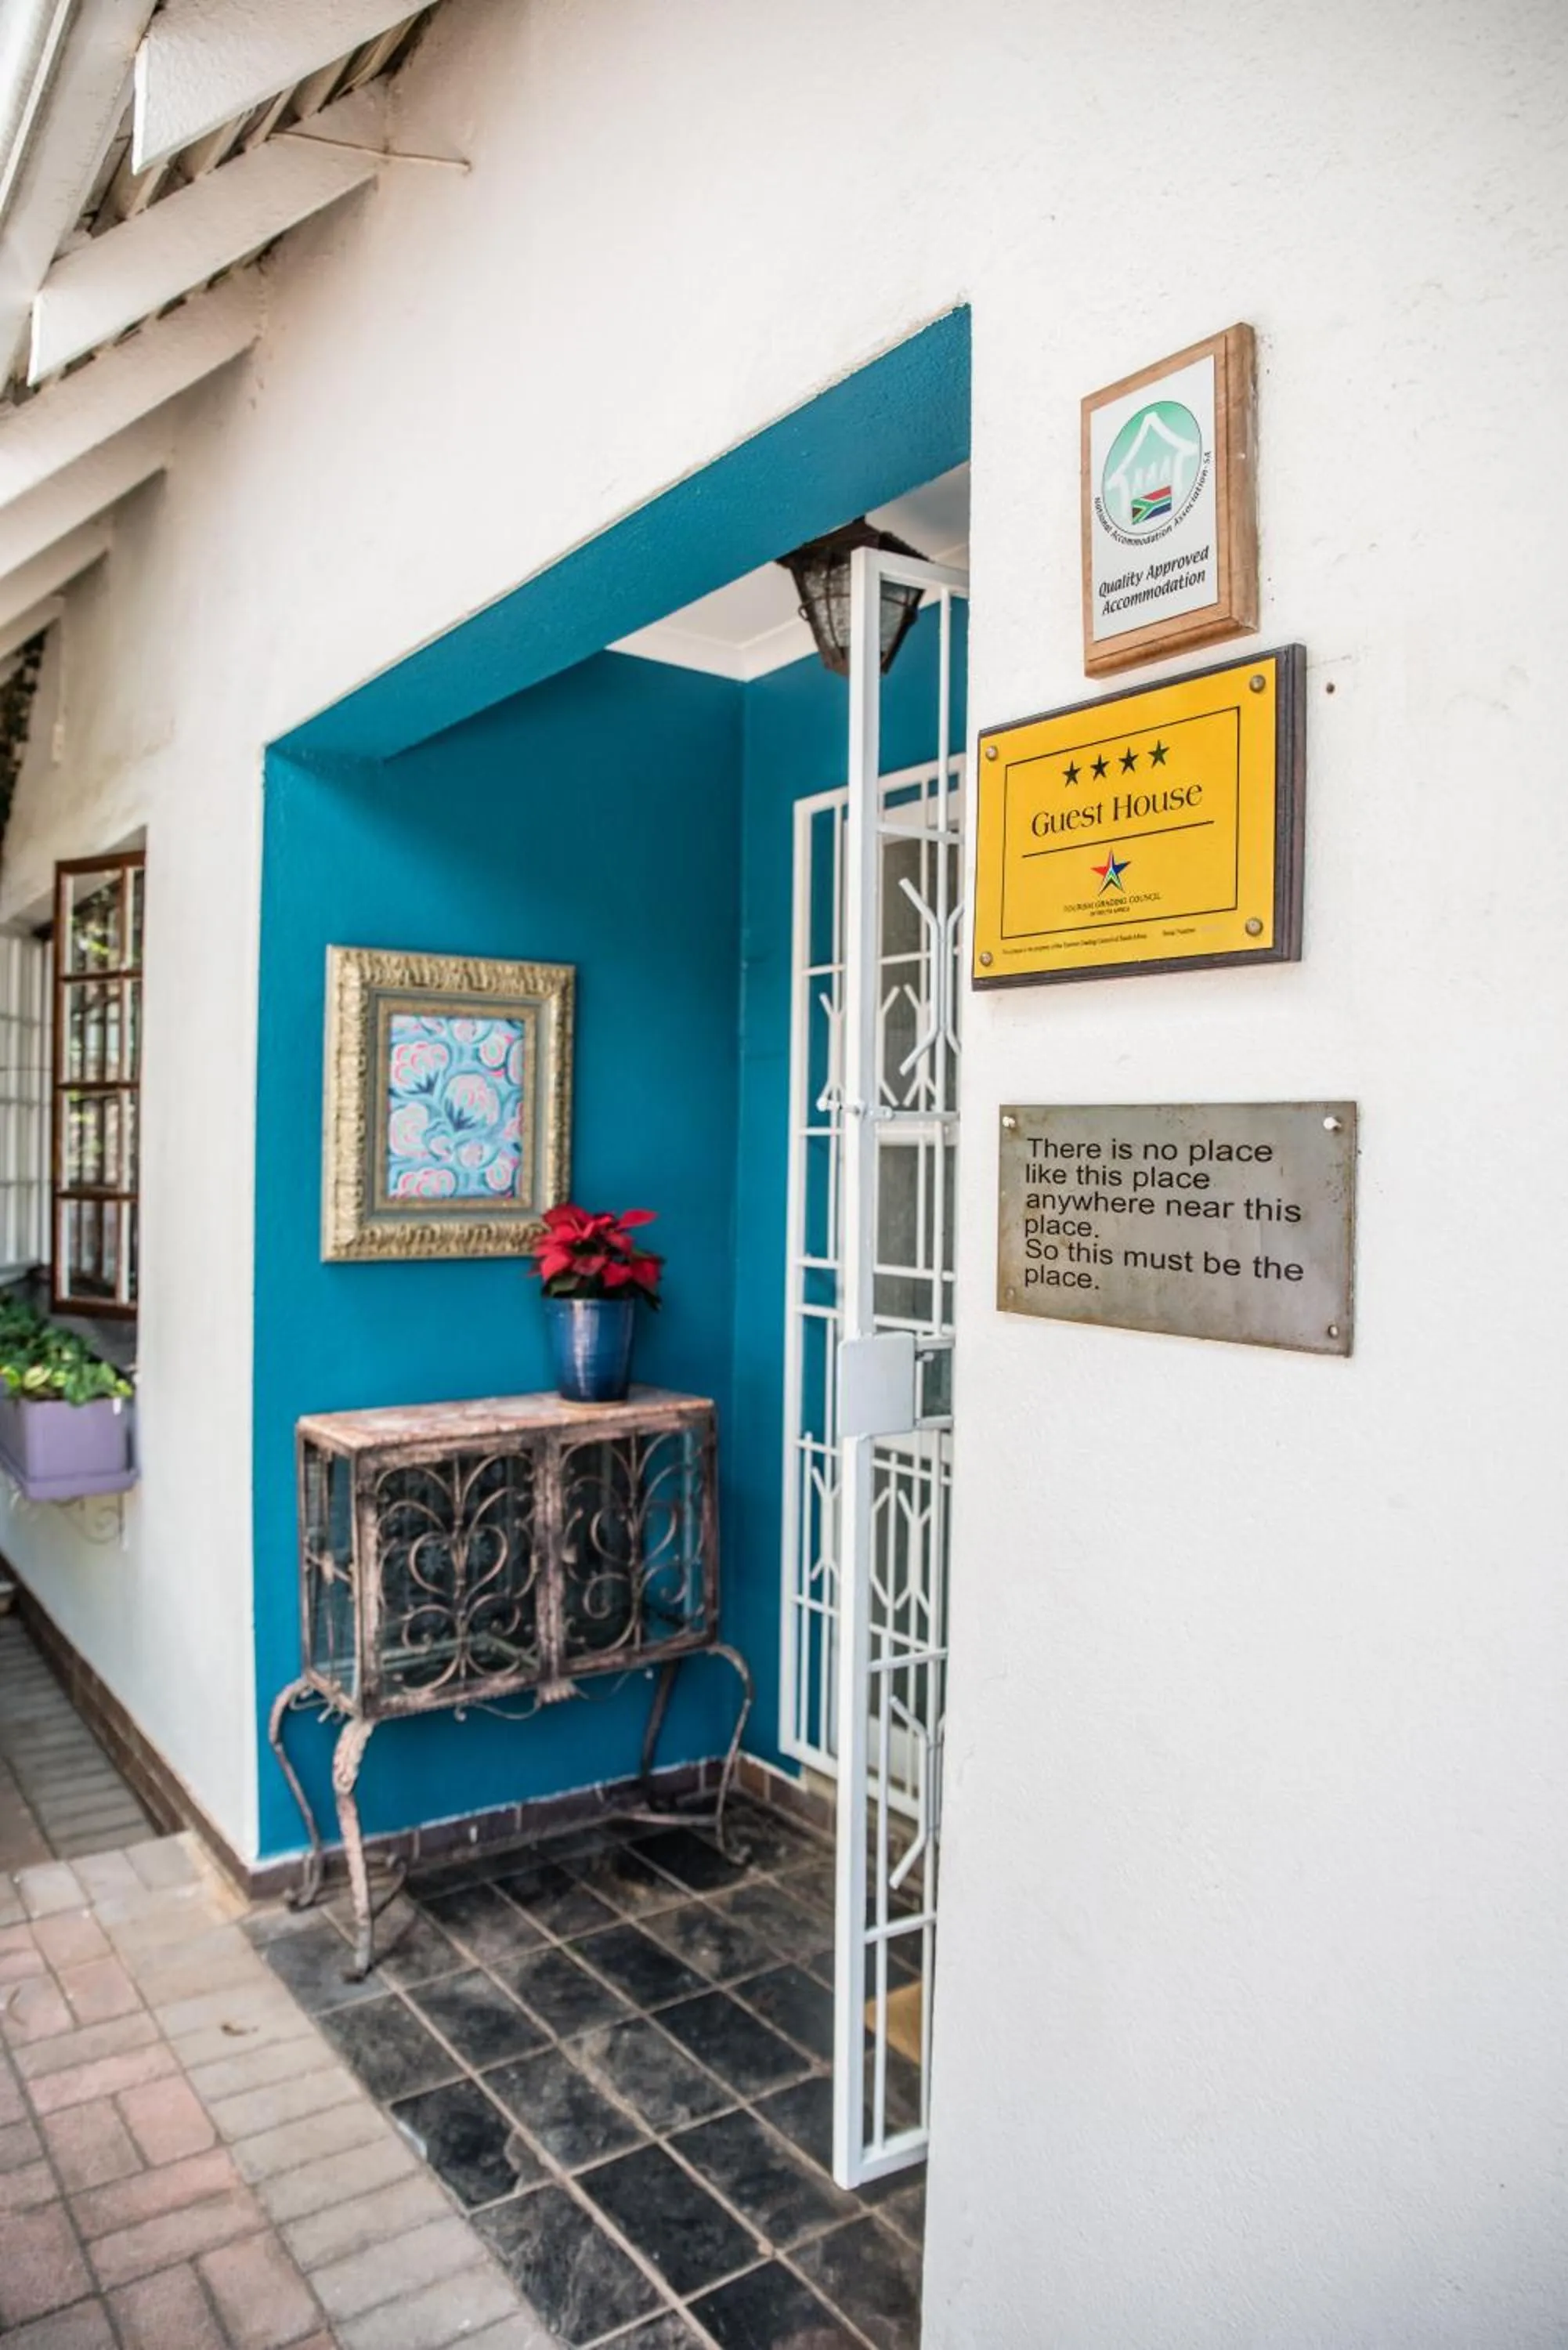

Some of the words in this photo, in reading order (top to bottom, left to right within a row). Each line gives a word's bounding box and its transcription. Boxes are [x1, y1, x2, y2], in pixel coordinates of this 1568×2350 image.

[1094, 497, 1111, 537] National
[1111, 525, 1172, 546] Accommodation
[1099, 569, 1143, 598] Quality
[1146, 545, 1209, 580] Approved
[1101, 569, 1205, 616] Accommodation
[1031, 801, 1103, 837] Guest
[1113, 783, 1203, 822] House
[1027, 1138, 1101, 1159] There
[1111, 1139, 1133, 1160] is
[1143, 1142, 1177, 1161] no
[1190, 1139, 1272, 1166] place
[1025, 1164, 1066, 1185] like
[1076, 1166, 1122, 1187] this
[1133, 1166, 1210, 1191] place
[1026, 1191, 1155, 1214] anywhere
[1166, 1199, 1234, 1217] near
[1244, 1198, 1302, 1223] this
[1024, 1215, 1100, 1238] place.
[1024, 1266, 1100, 1289] place.
[1025, 1239, 1058, 1260] So
[1069, 1242, 1113, 1265] this
[1124, 1250, 1193, 1273] must
[1204, 1252, 1241, 1276] be
[1253, 1256, 1303, 1282] the
